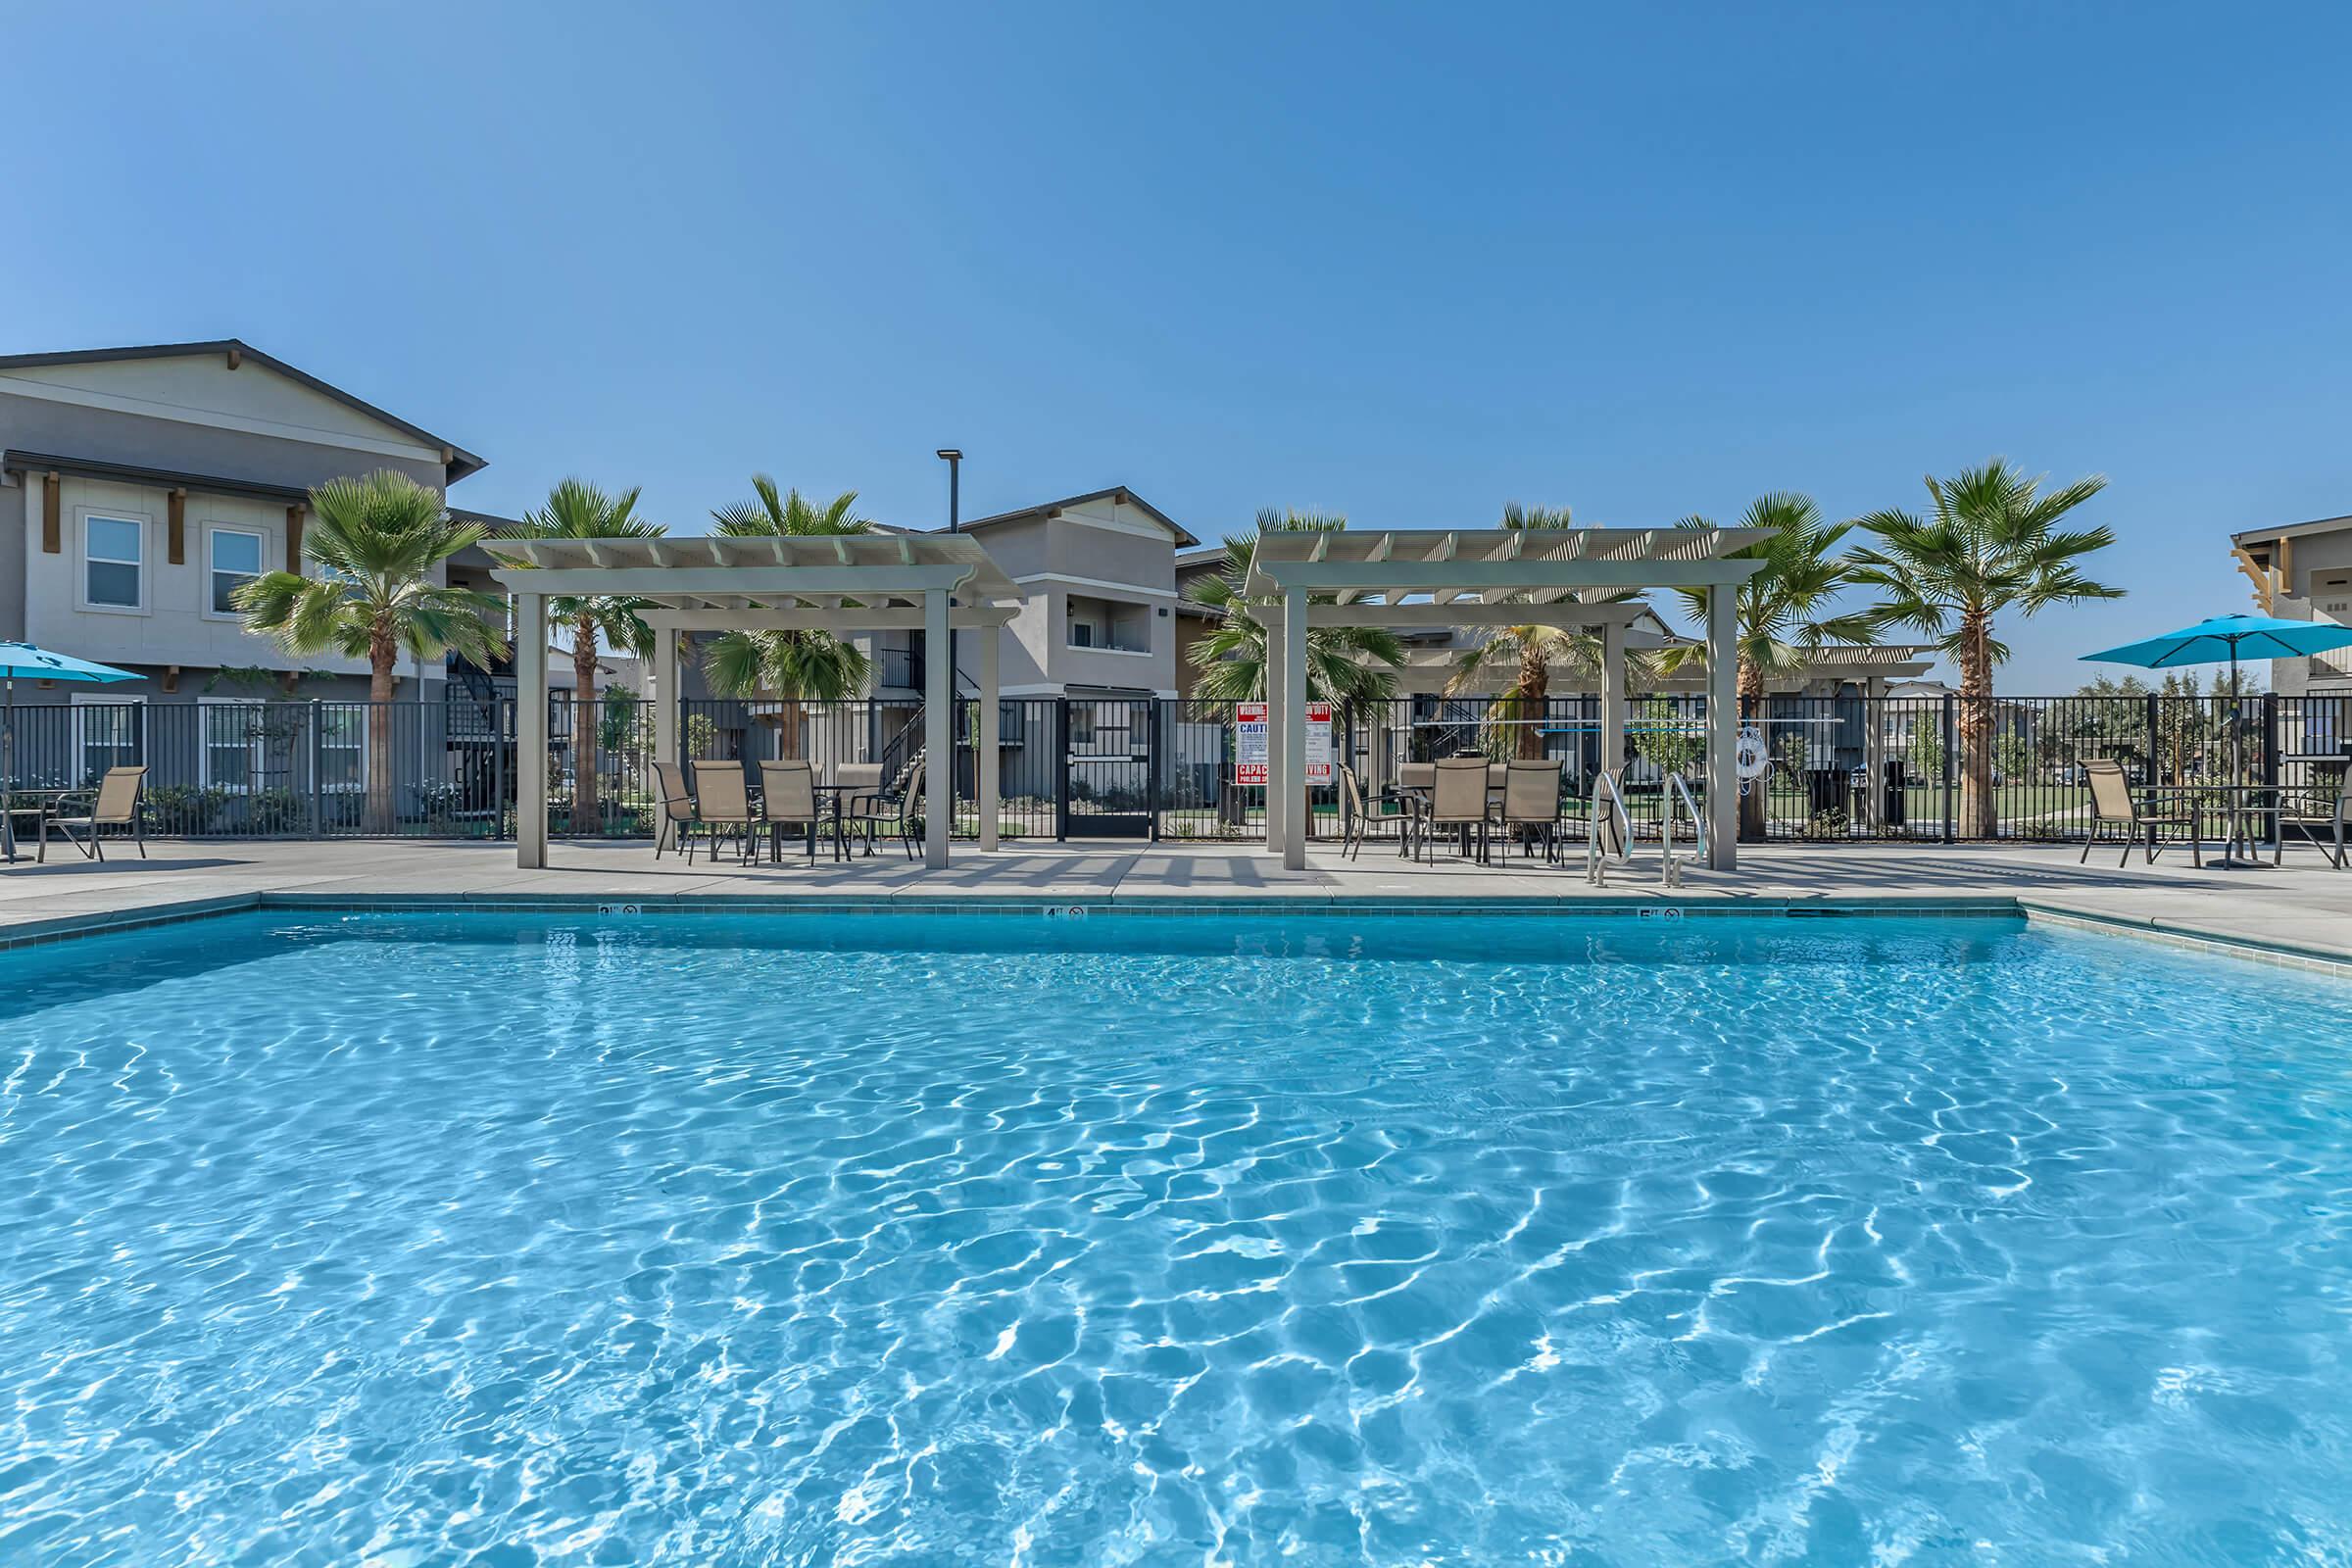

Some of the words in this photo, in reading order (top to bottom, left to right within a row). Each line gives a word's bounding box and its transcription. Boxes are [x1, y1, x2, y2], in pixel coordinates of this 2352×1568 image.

[1240, 724, 1267, 733] CAUTI
[1240, 765, 1268, 775] CAPAC
[1305, 764, 1328, 774] IVING
